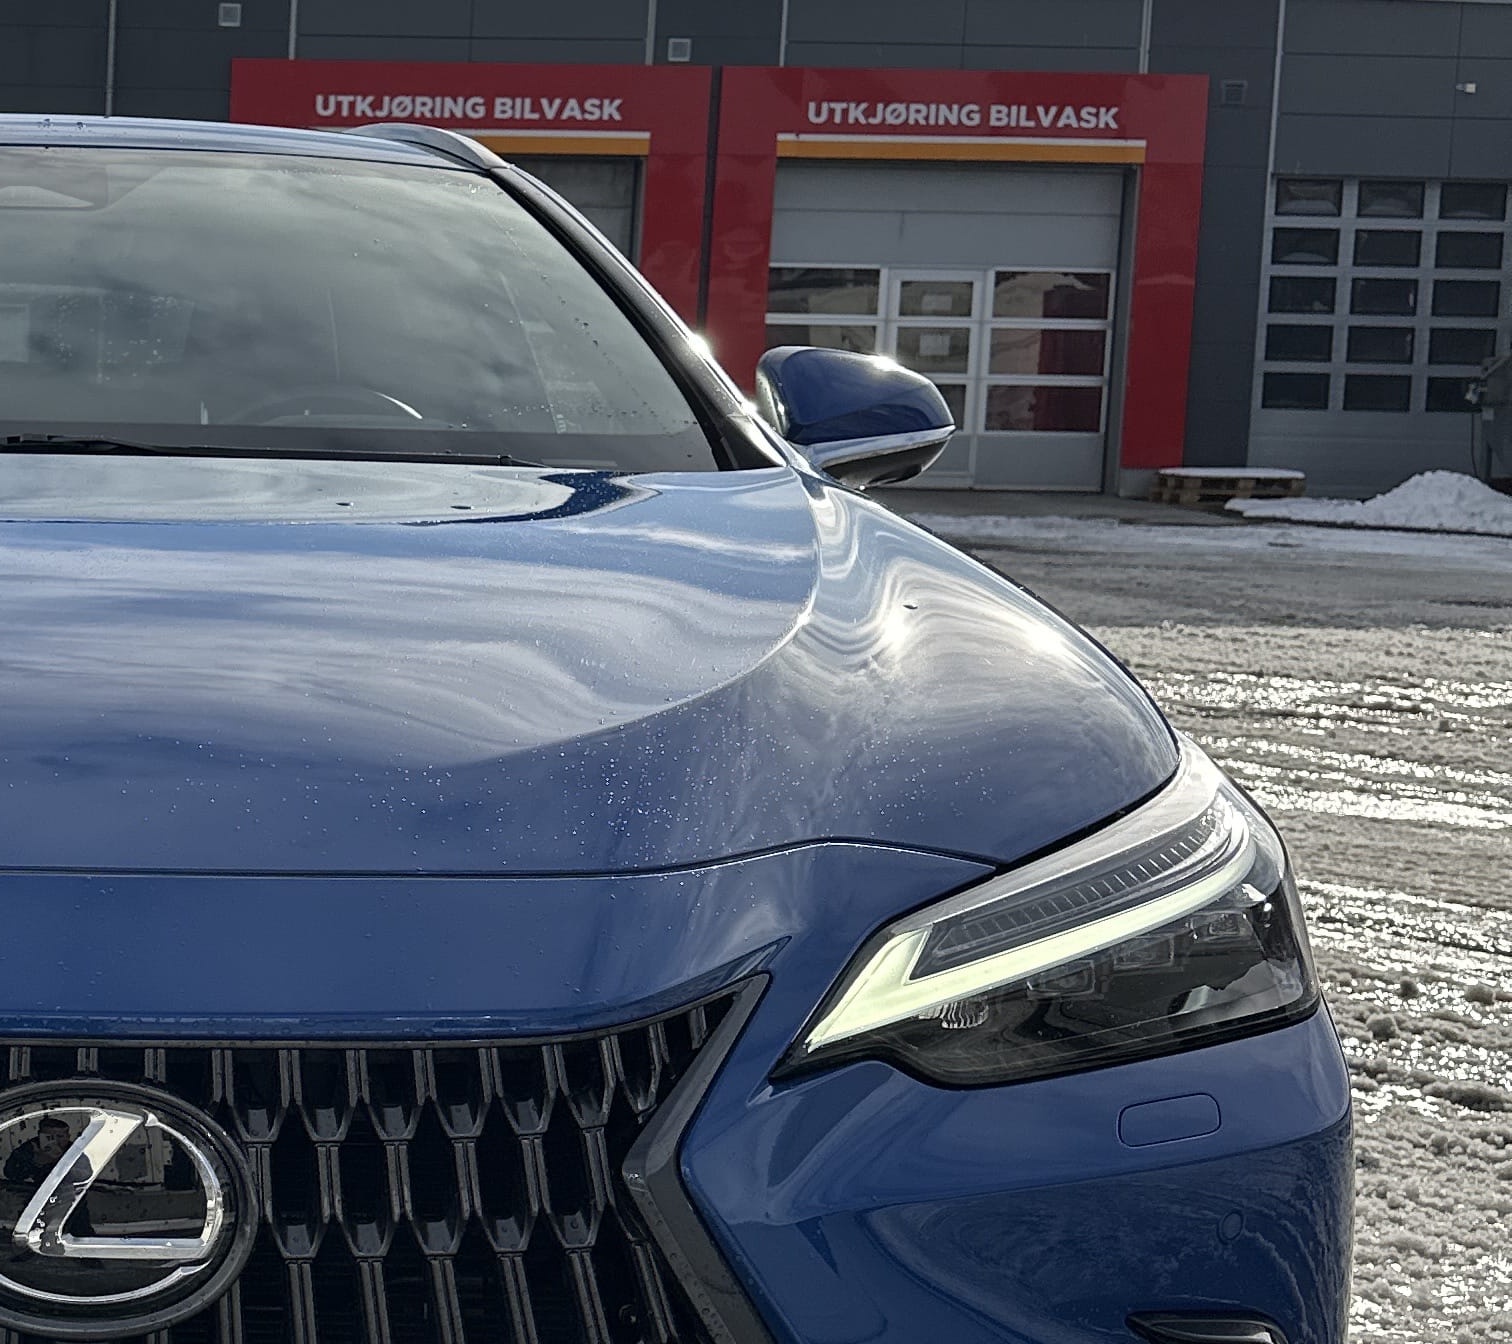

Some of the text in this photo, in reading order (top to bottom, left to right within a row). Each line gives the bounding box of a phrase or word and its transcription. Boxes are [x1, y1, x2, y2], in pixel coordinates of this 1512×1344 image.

[315, 94, 622, 121] UTKJØRING BILVASK
[807, 101, 1119, 130] UTKJØRING BILVASK
